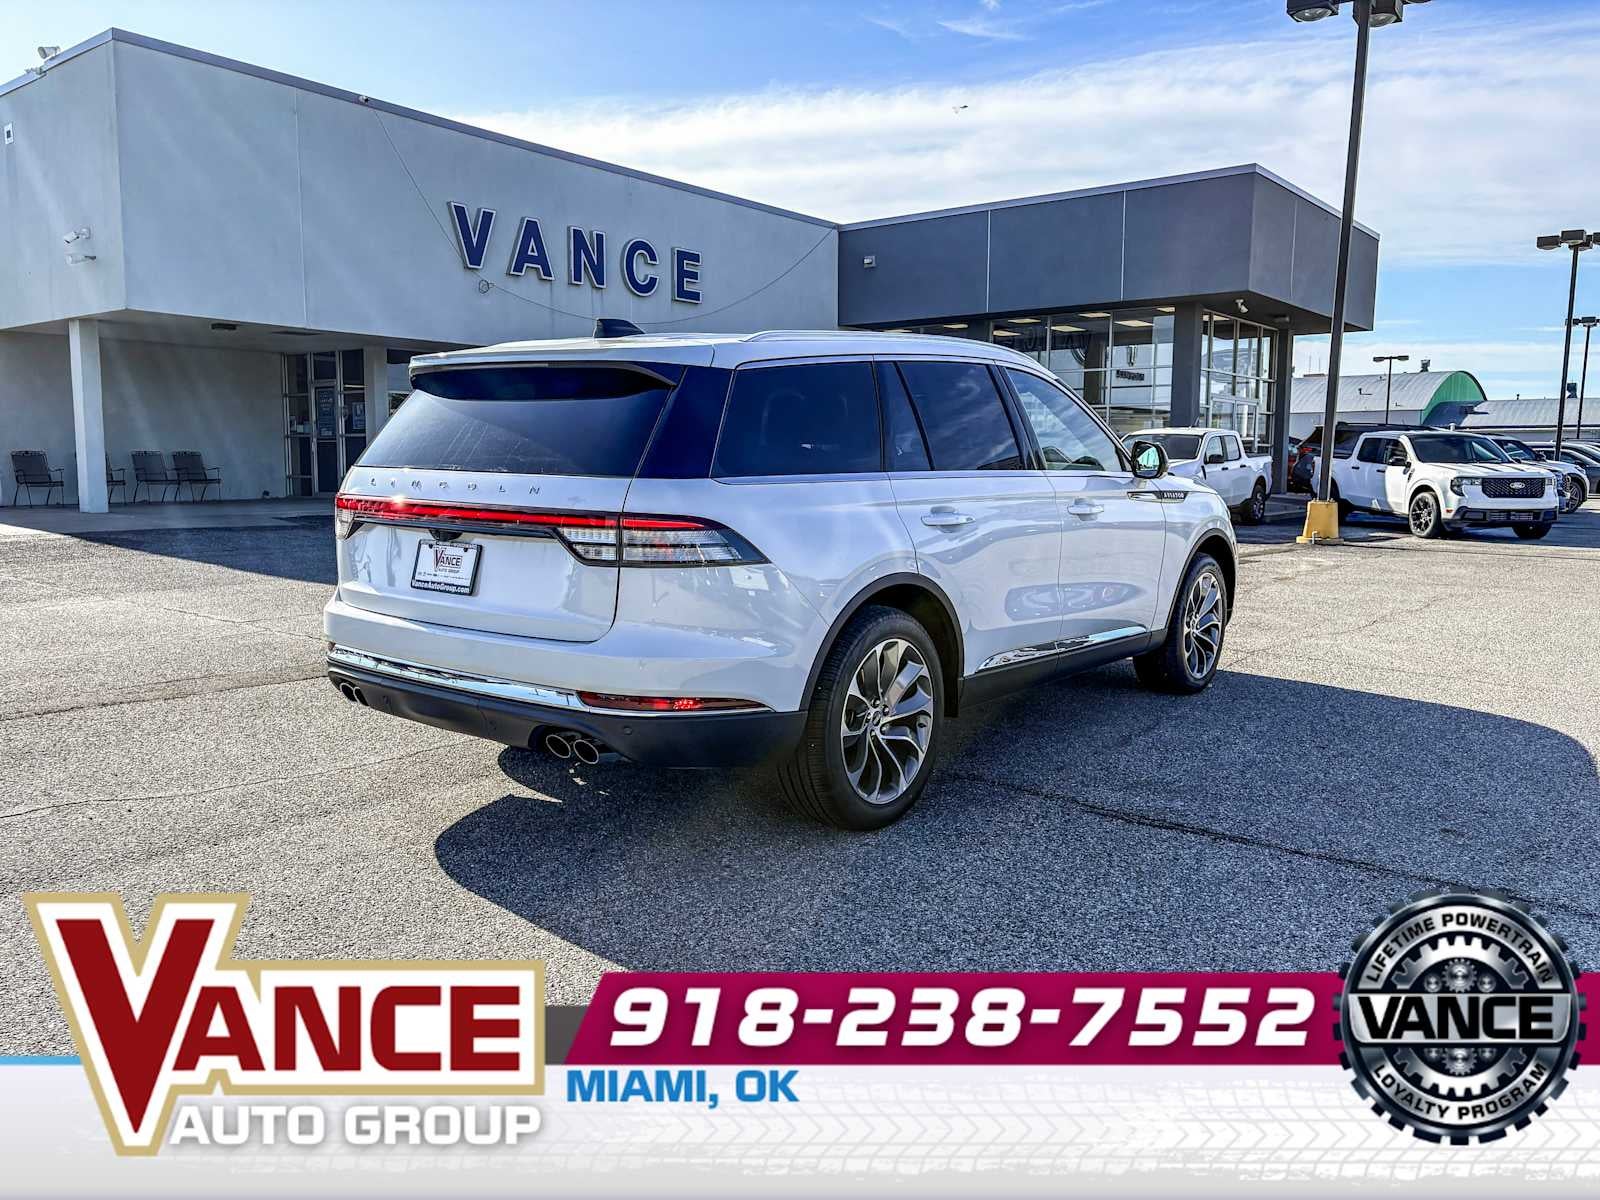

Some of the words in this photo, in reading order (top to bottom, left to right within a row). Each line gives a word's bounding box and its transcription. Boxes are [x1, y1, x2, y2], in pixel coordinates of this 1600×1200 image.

[448, 201, 702, 304] VANCE
[435, 549, 461, 569] VANCE
[412, 581, 470, 594] VanceAutoGroup.com
